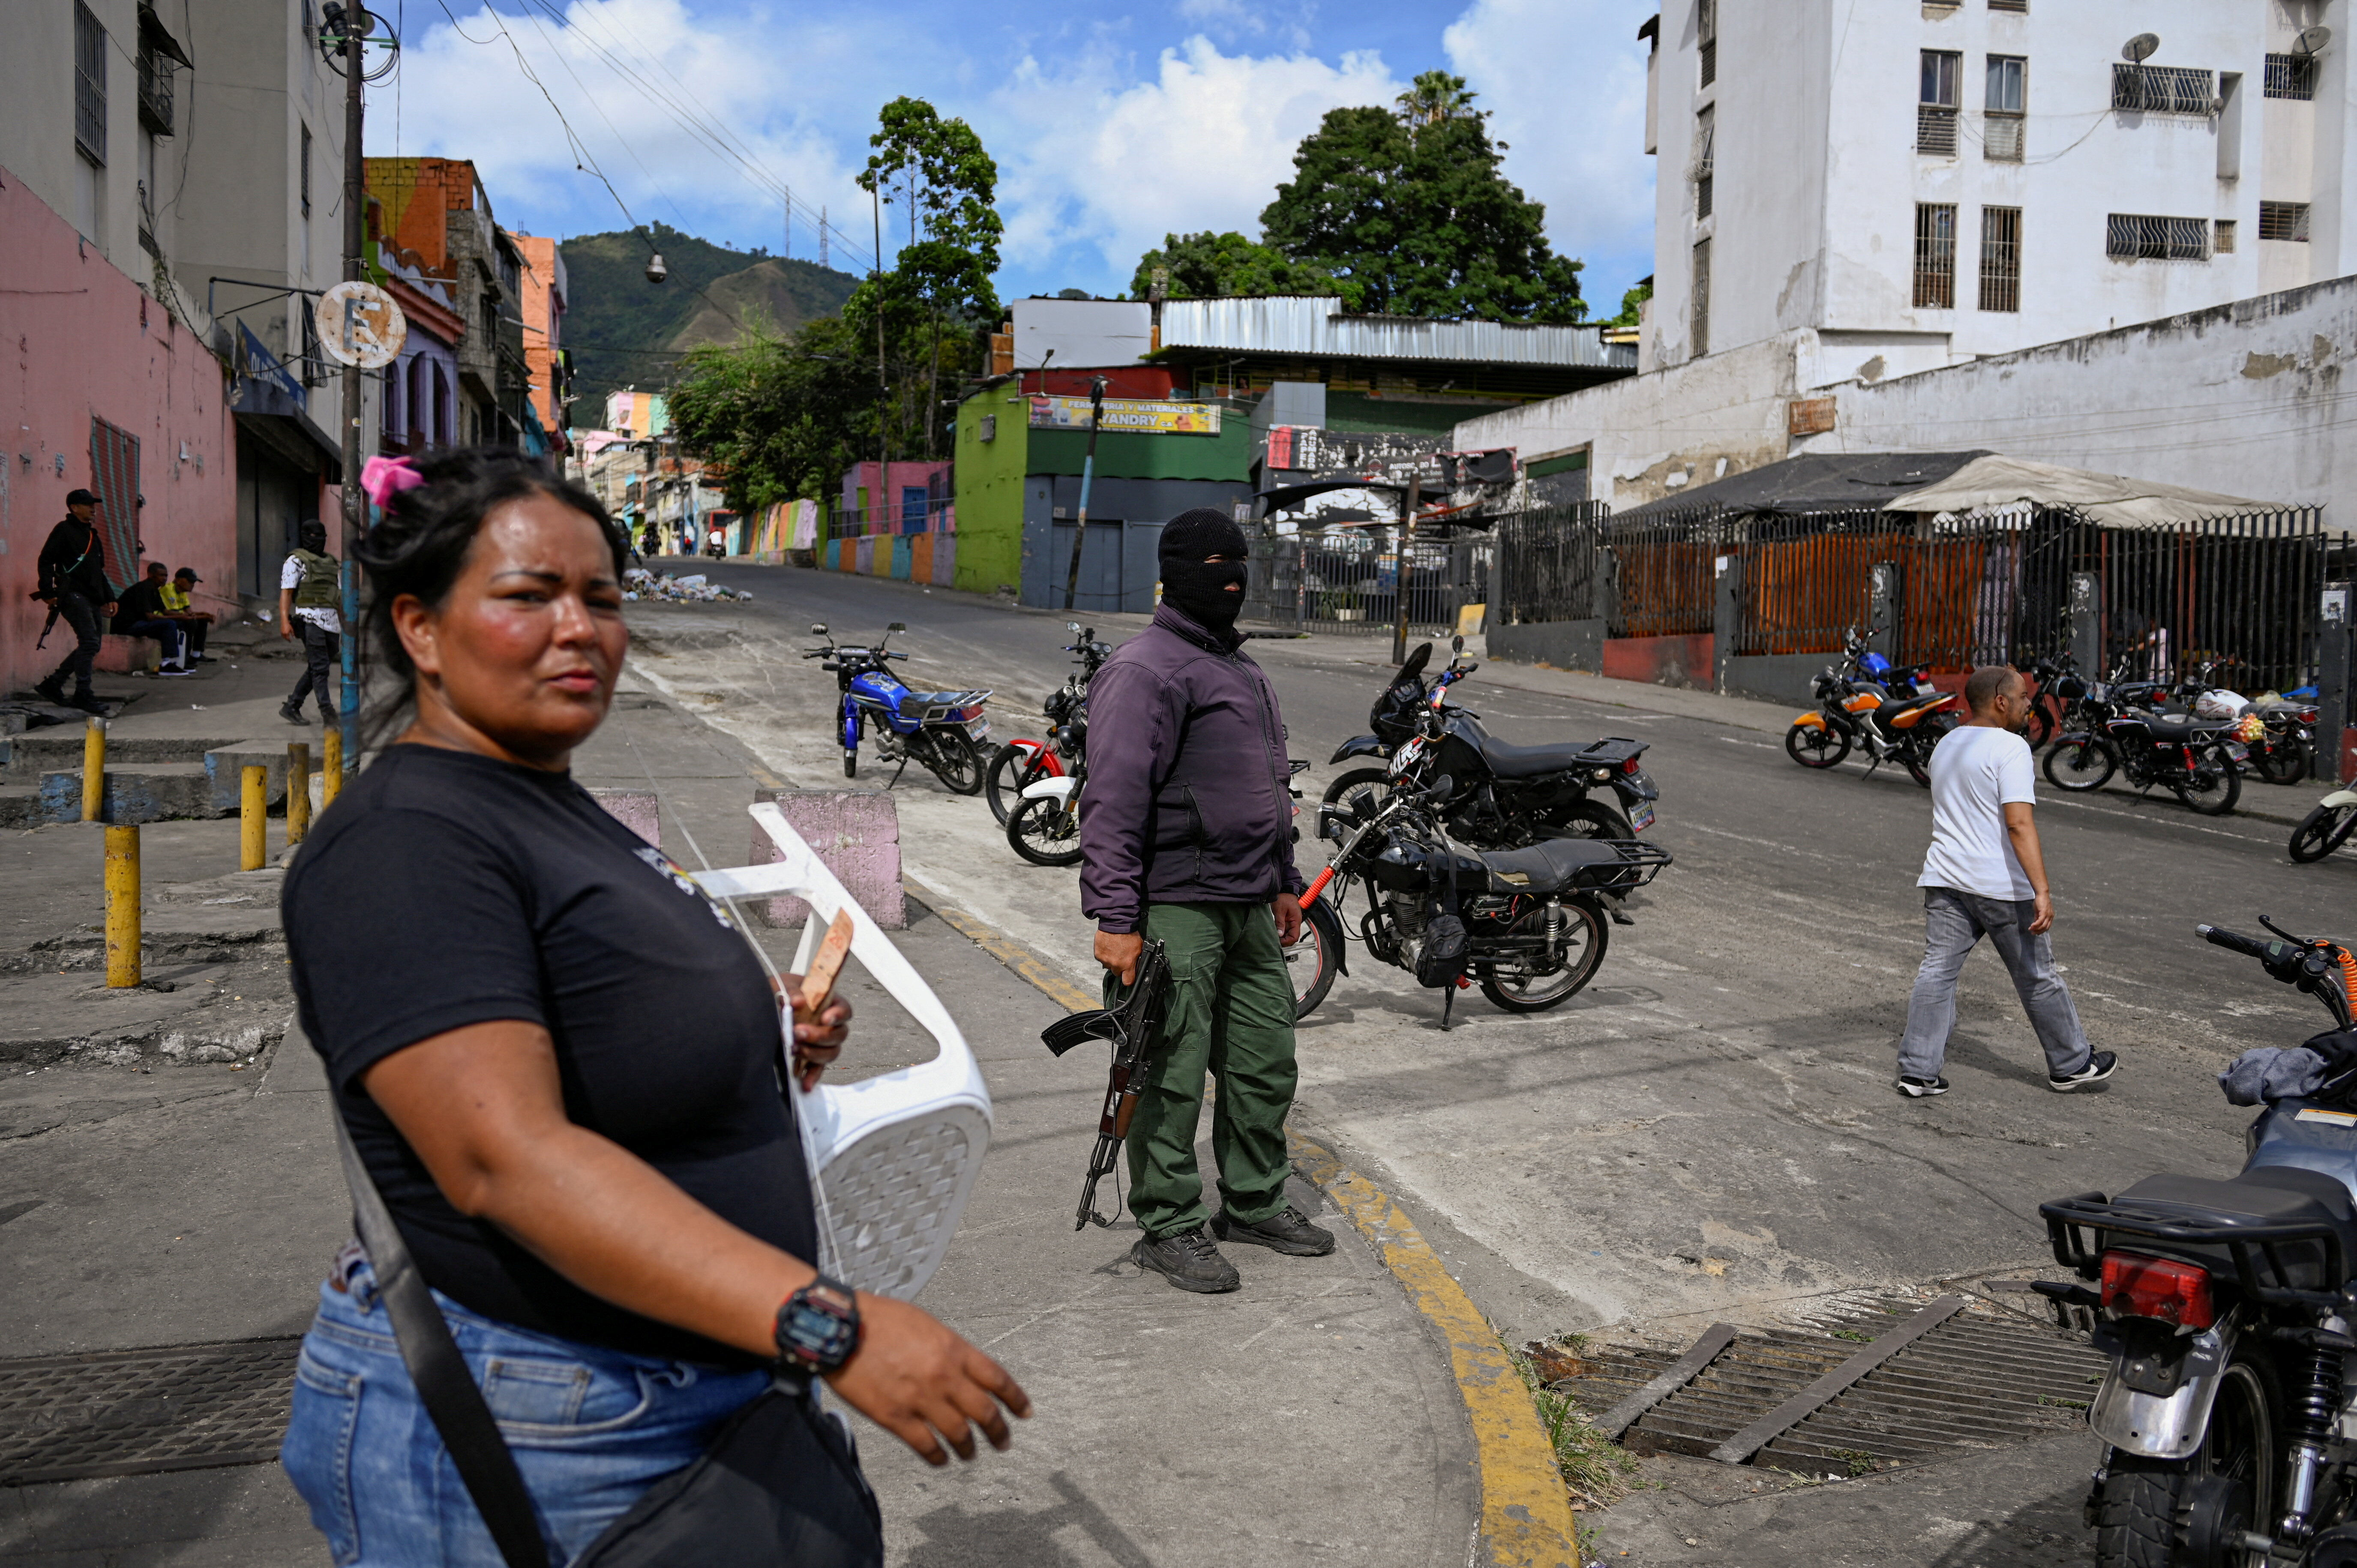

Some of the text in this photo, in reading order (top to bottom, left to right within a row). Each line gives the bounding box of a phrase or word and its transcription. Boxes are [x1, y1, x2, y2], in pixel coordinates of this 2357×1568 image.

[1102, 413, 1158, 426] YANDRY
[1137, 404, 1194, 414] MATERIALES
[1299, 432, 1308, 468] PAPEL
[1307, 429, 1317, 470] AHUMADO
